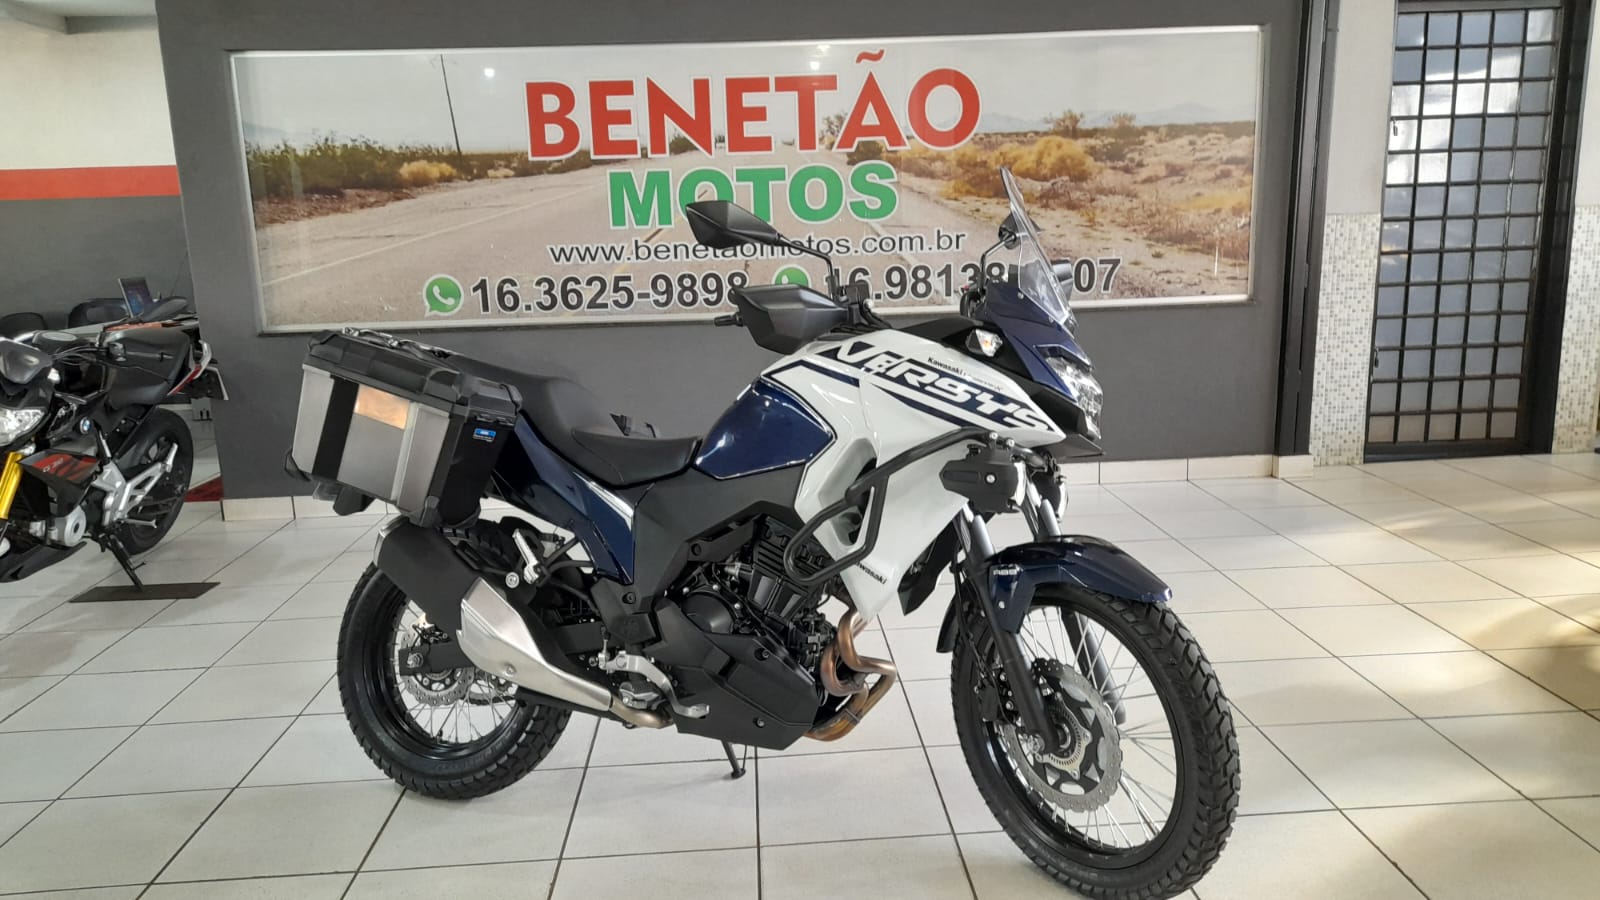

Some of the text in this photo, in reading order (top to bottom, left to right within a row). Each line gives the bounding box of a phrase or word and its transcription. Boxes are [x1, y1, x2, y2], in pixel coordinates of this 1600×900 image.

[524, 48, 982, 160] BENETÃO
[607, 162, 898, 228] MOTOS
[472, 271, 748, 313] 16.3625-9898
[927, 356, 964, 375] Kawasaki
[855, 561, 887, 584] awasaki
